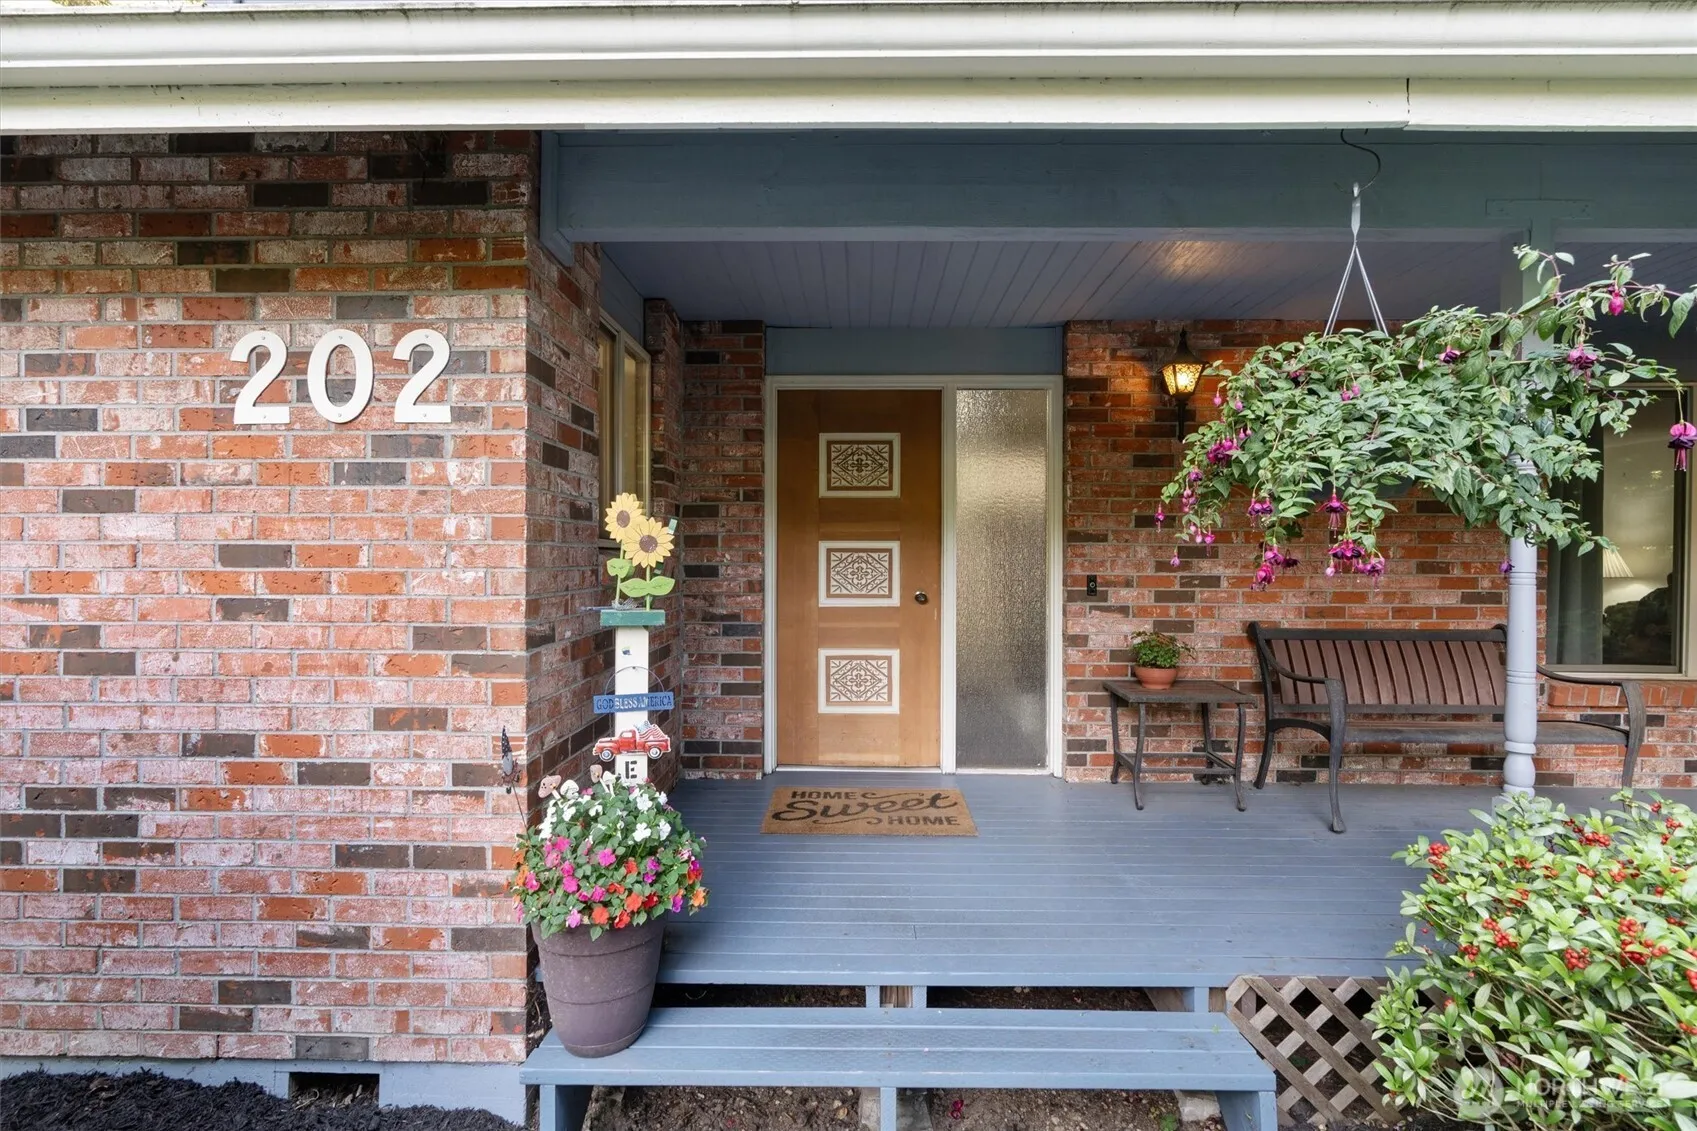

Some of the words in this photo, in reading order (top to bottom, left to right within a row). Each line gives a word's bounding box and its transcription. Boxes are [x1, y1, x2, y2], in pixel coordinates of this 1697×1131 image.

[230, 328, 451, 424] 202
[596, 698, 614, 710] GOD
[614, 697, 638, 709] BLESS
[638, 695, 672, 708] AMERICA
[625, 760, 638, 779] E
[791, 790, 858, 800] HOME
[772, 792, 958, 821] Sweet
[888, 815, 961, 826] HOME
